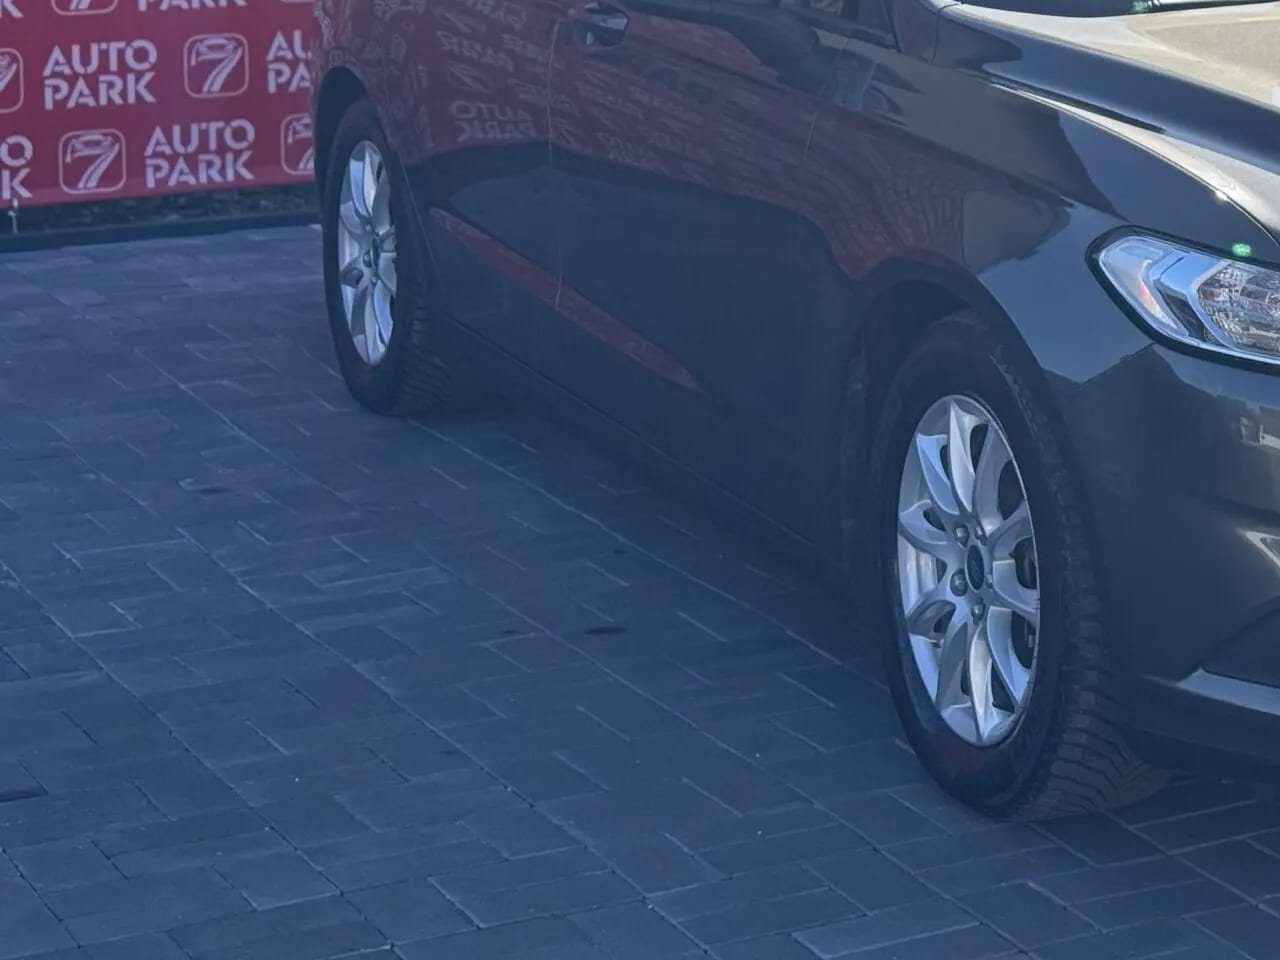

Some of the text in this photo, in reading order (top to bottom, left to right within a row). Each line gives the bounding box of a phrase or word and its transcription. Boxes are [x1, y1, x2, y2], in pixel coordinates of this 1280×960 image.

[43, 40, 157, 76] AUTO
[44, 72, 155, 110] PARK
[144, 119, 255, 156] AUTO
[146, 151, 255, 189] PARK
